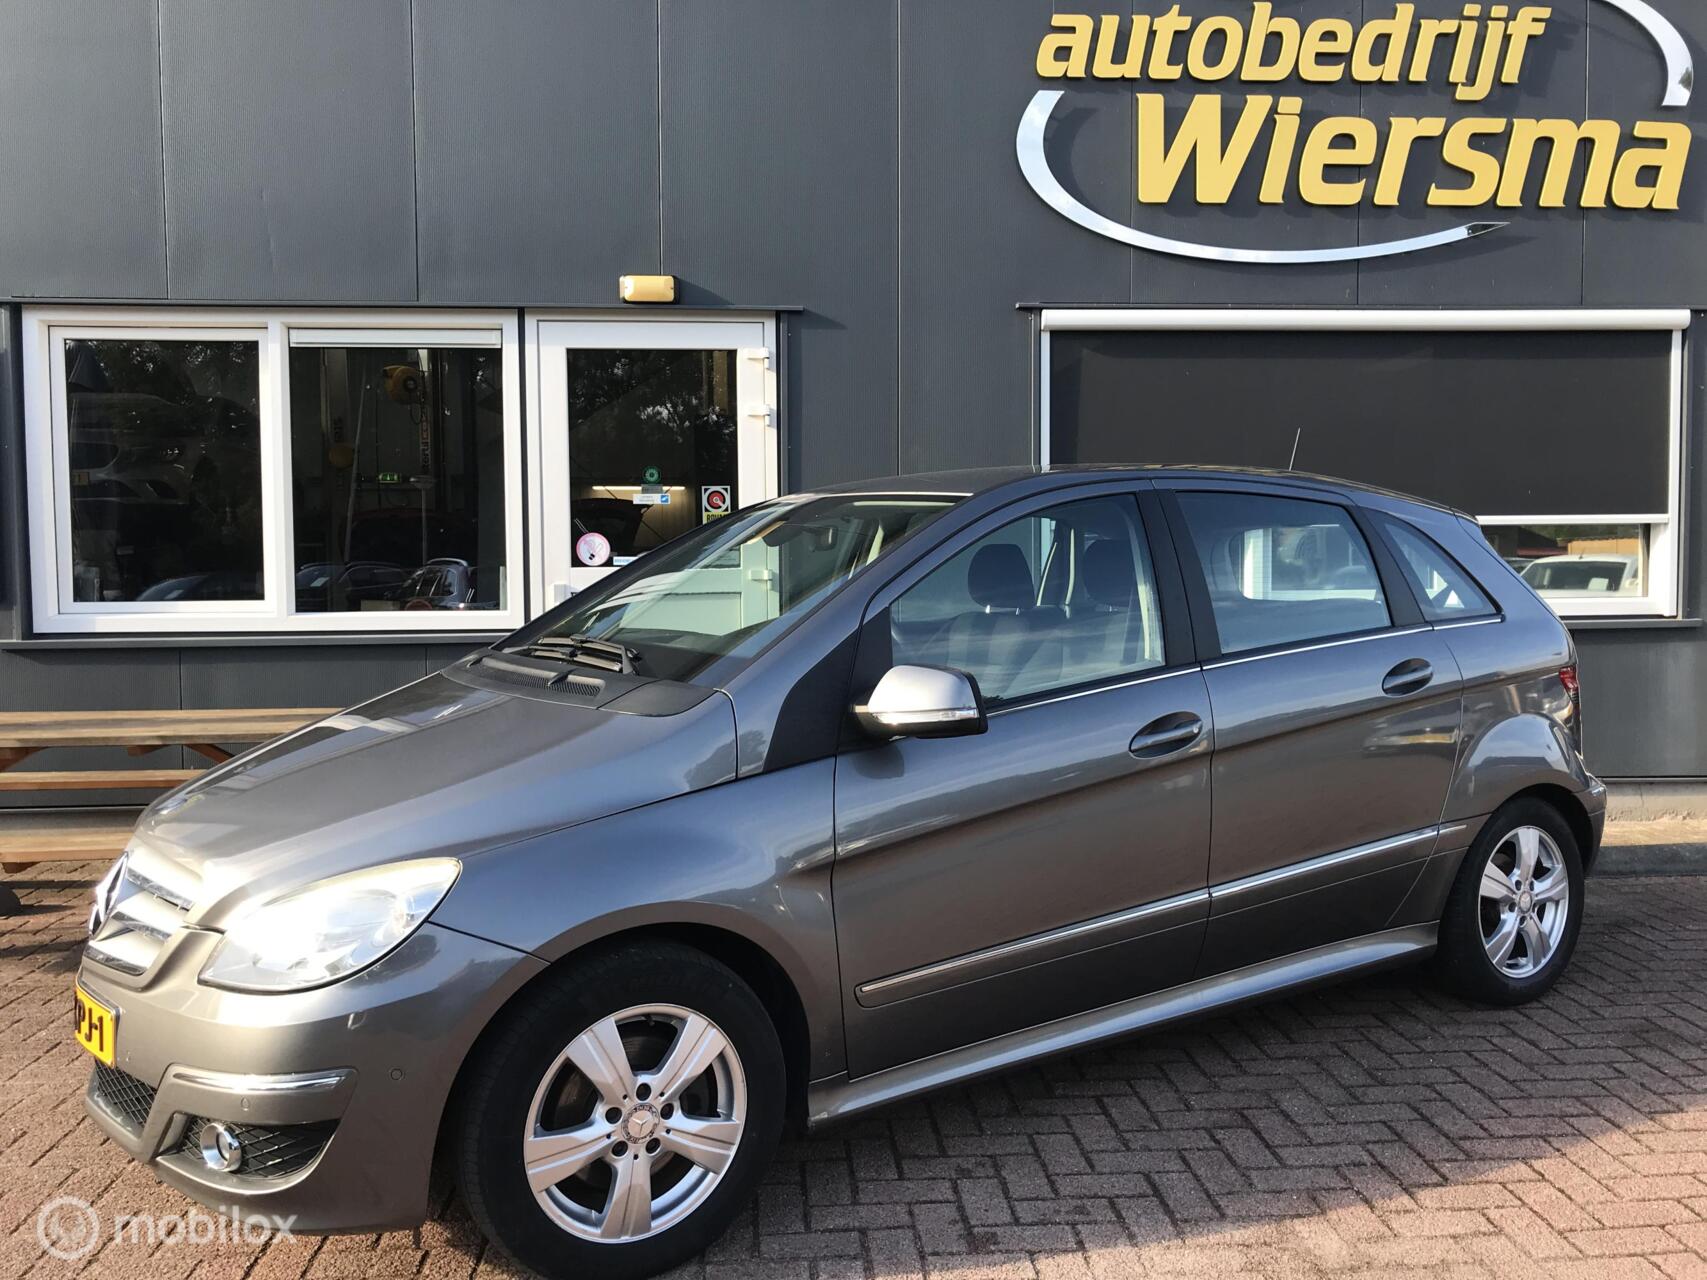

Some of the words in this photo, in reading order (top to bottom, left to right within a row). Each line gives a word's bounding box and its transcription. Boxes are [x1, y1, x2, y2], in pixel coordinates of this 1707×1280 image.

[1036, 1, 1552, 101] autobedrijf
[1136, 93, 1693, 210] Wiersma
[75, 990, 104, 1053] PJ-1
